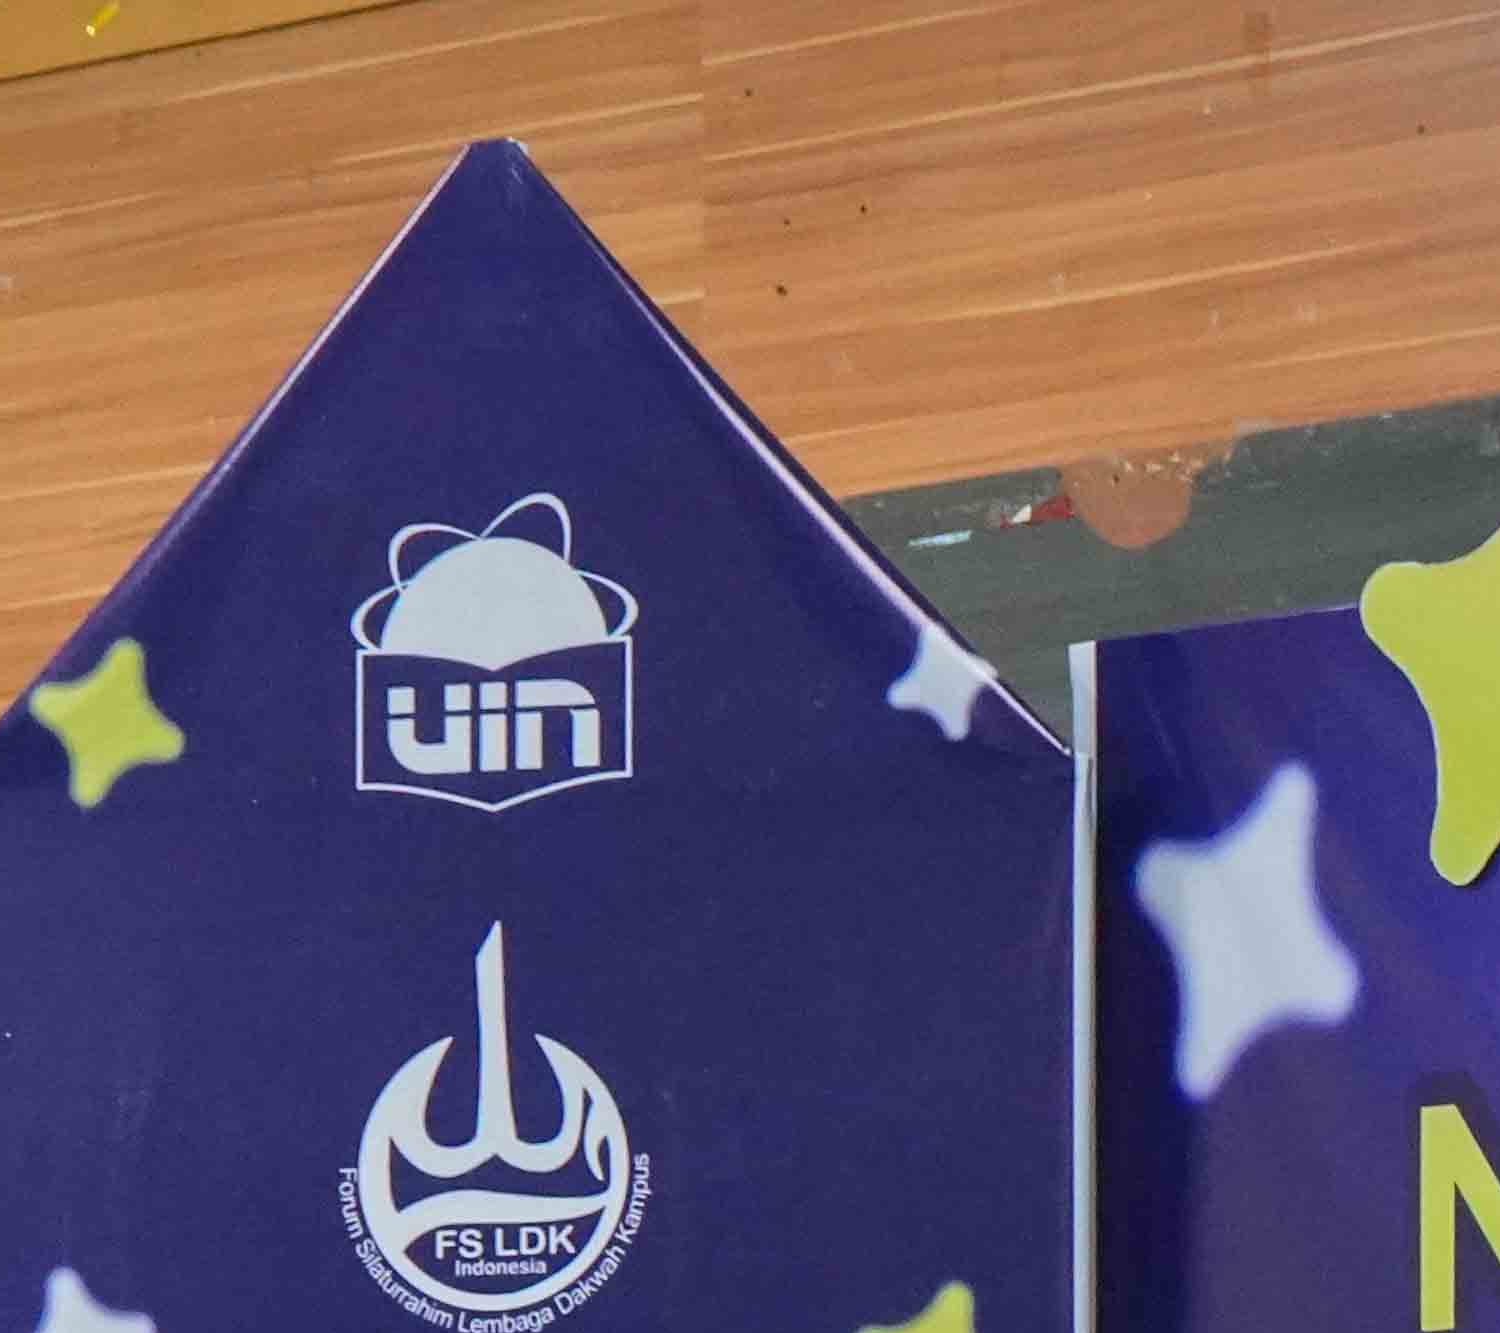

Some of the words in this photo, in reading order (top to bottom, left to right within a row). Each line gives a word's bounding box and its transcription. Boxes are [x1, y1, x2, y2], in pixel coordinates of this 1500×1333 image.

[338, 1166, 364, 1240] Forum
[354, 1237, 454, 1329] Silaturrahim
[554, 1244, 626, 1315] Dakwah
[615, 1152, 653, 1246] Kampus
[435, 1229, 483, 1260] FS
[495, 1225, 576, 1256] LDK
[455, 1258, 547, 1277] Indonesia
